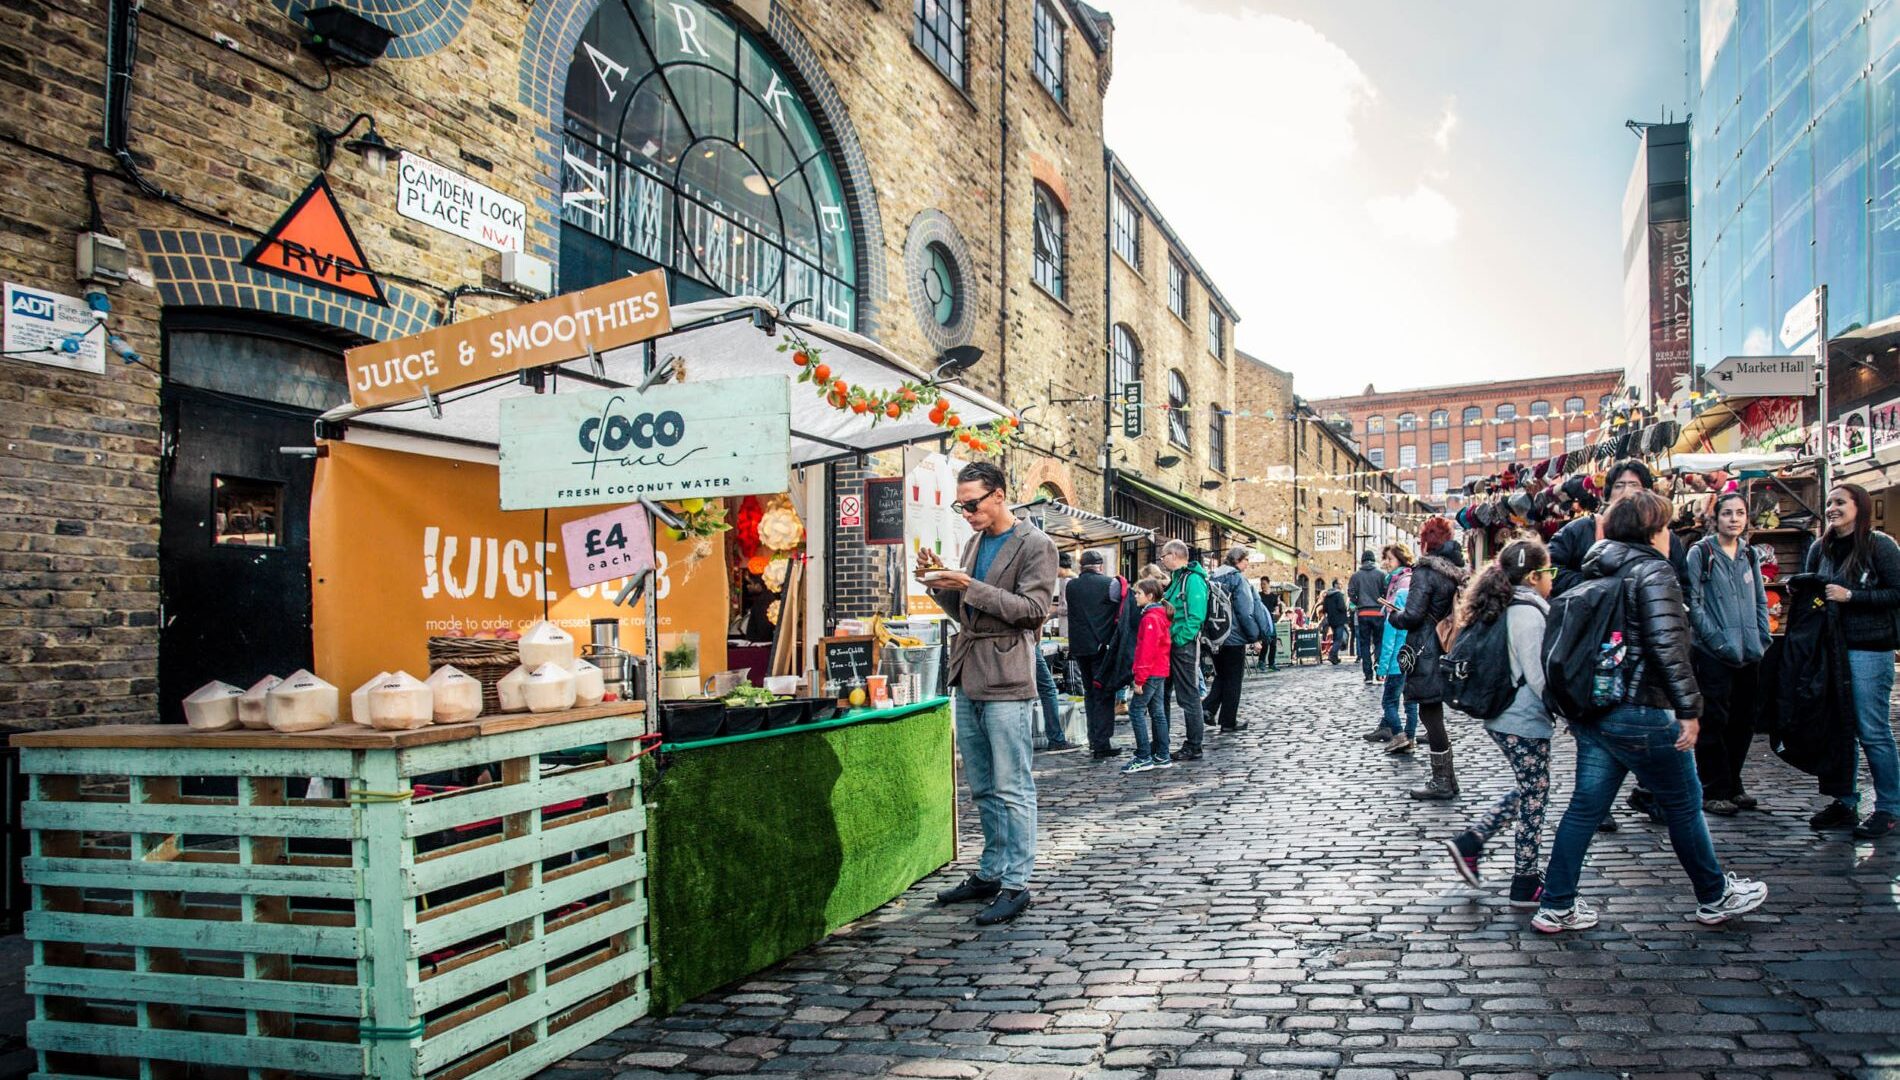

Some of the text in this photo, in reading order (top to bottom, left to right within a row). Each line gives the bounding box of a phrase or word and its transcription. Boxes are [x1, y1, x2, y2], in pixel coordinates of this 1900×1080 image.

[402, 164, 524, 230] CAMDEN LOCK
[406, 187, 517, 250] PLACE NW1
[282, 239, 358, 282] RVP
[13, 295, 52, 317] ADT
[58, 304, 77, 314] Fire
[1674, 293, 1690, 341] Zulu
[356, 291, 660, 392] JUICE & SMOOTHIES
[1736, 362, 1805, 374] Market Hall
[579, 410, 685, 453] COCO
[558, 478, 731, 498] FRESH COCONUT WATER
[585, 523, 628, 557] £4
[421, 526, 557, 600] JUICE
[588, 553, 632, 572] each
[426, 616, 463, 631] made
[467, 616, 478, 630] to
[481, 616, 513, 630] order
